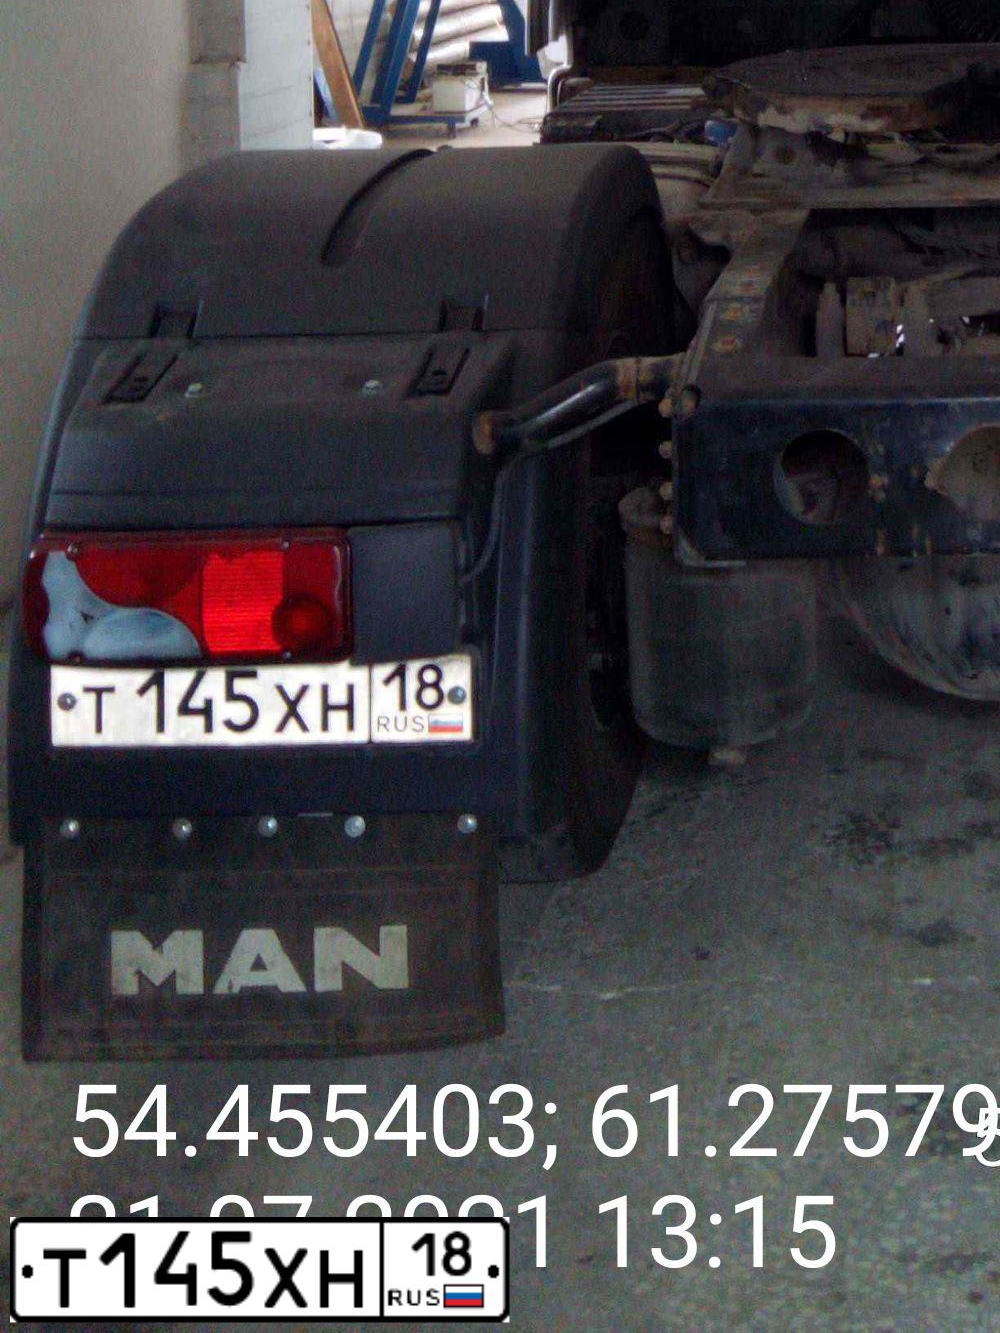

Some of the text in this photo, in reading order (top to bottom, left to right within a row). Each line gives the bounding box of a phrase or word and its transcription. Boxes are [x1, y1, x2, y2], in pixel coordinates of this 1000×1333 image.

[383, 664, 444, 712] 18
[377, 715, 425, 734] RUS
[110, 925, 409, 995] MAN
